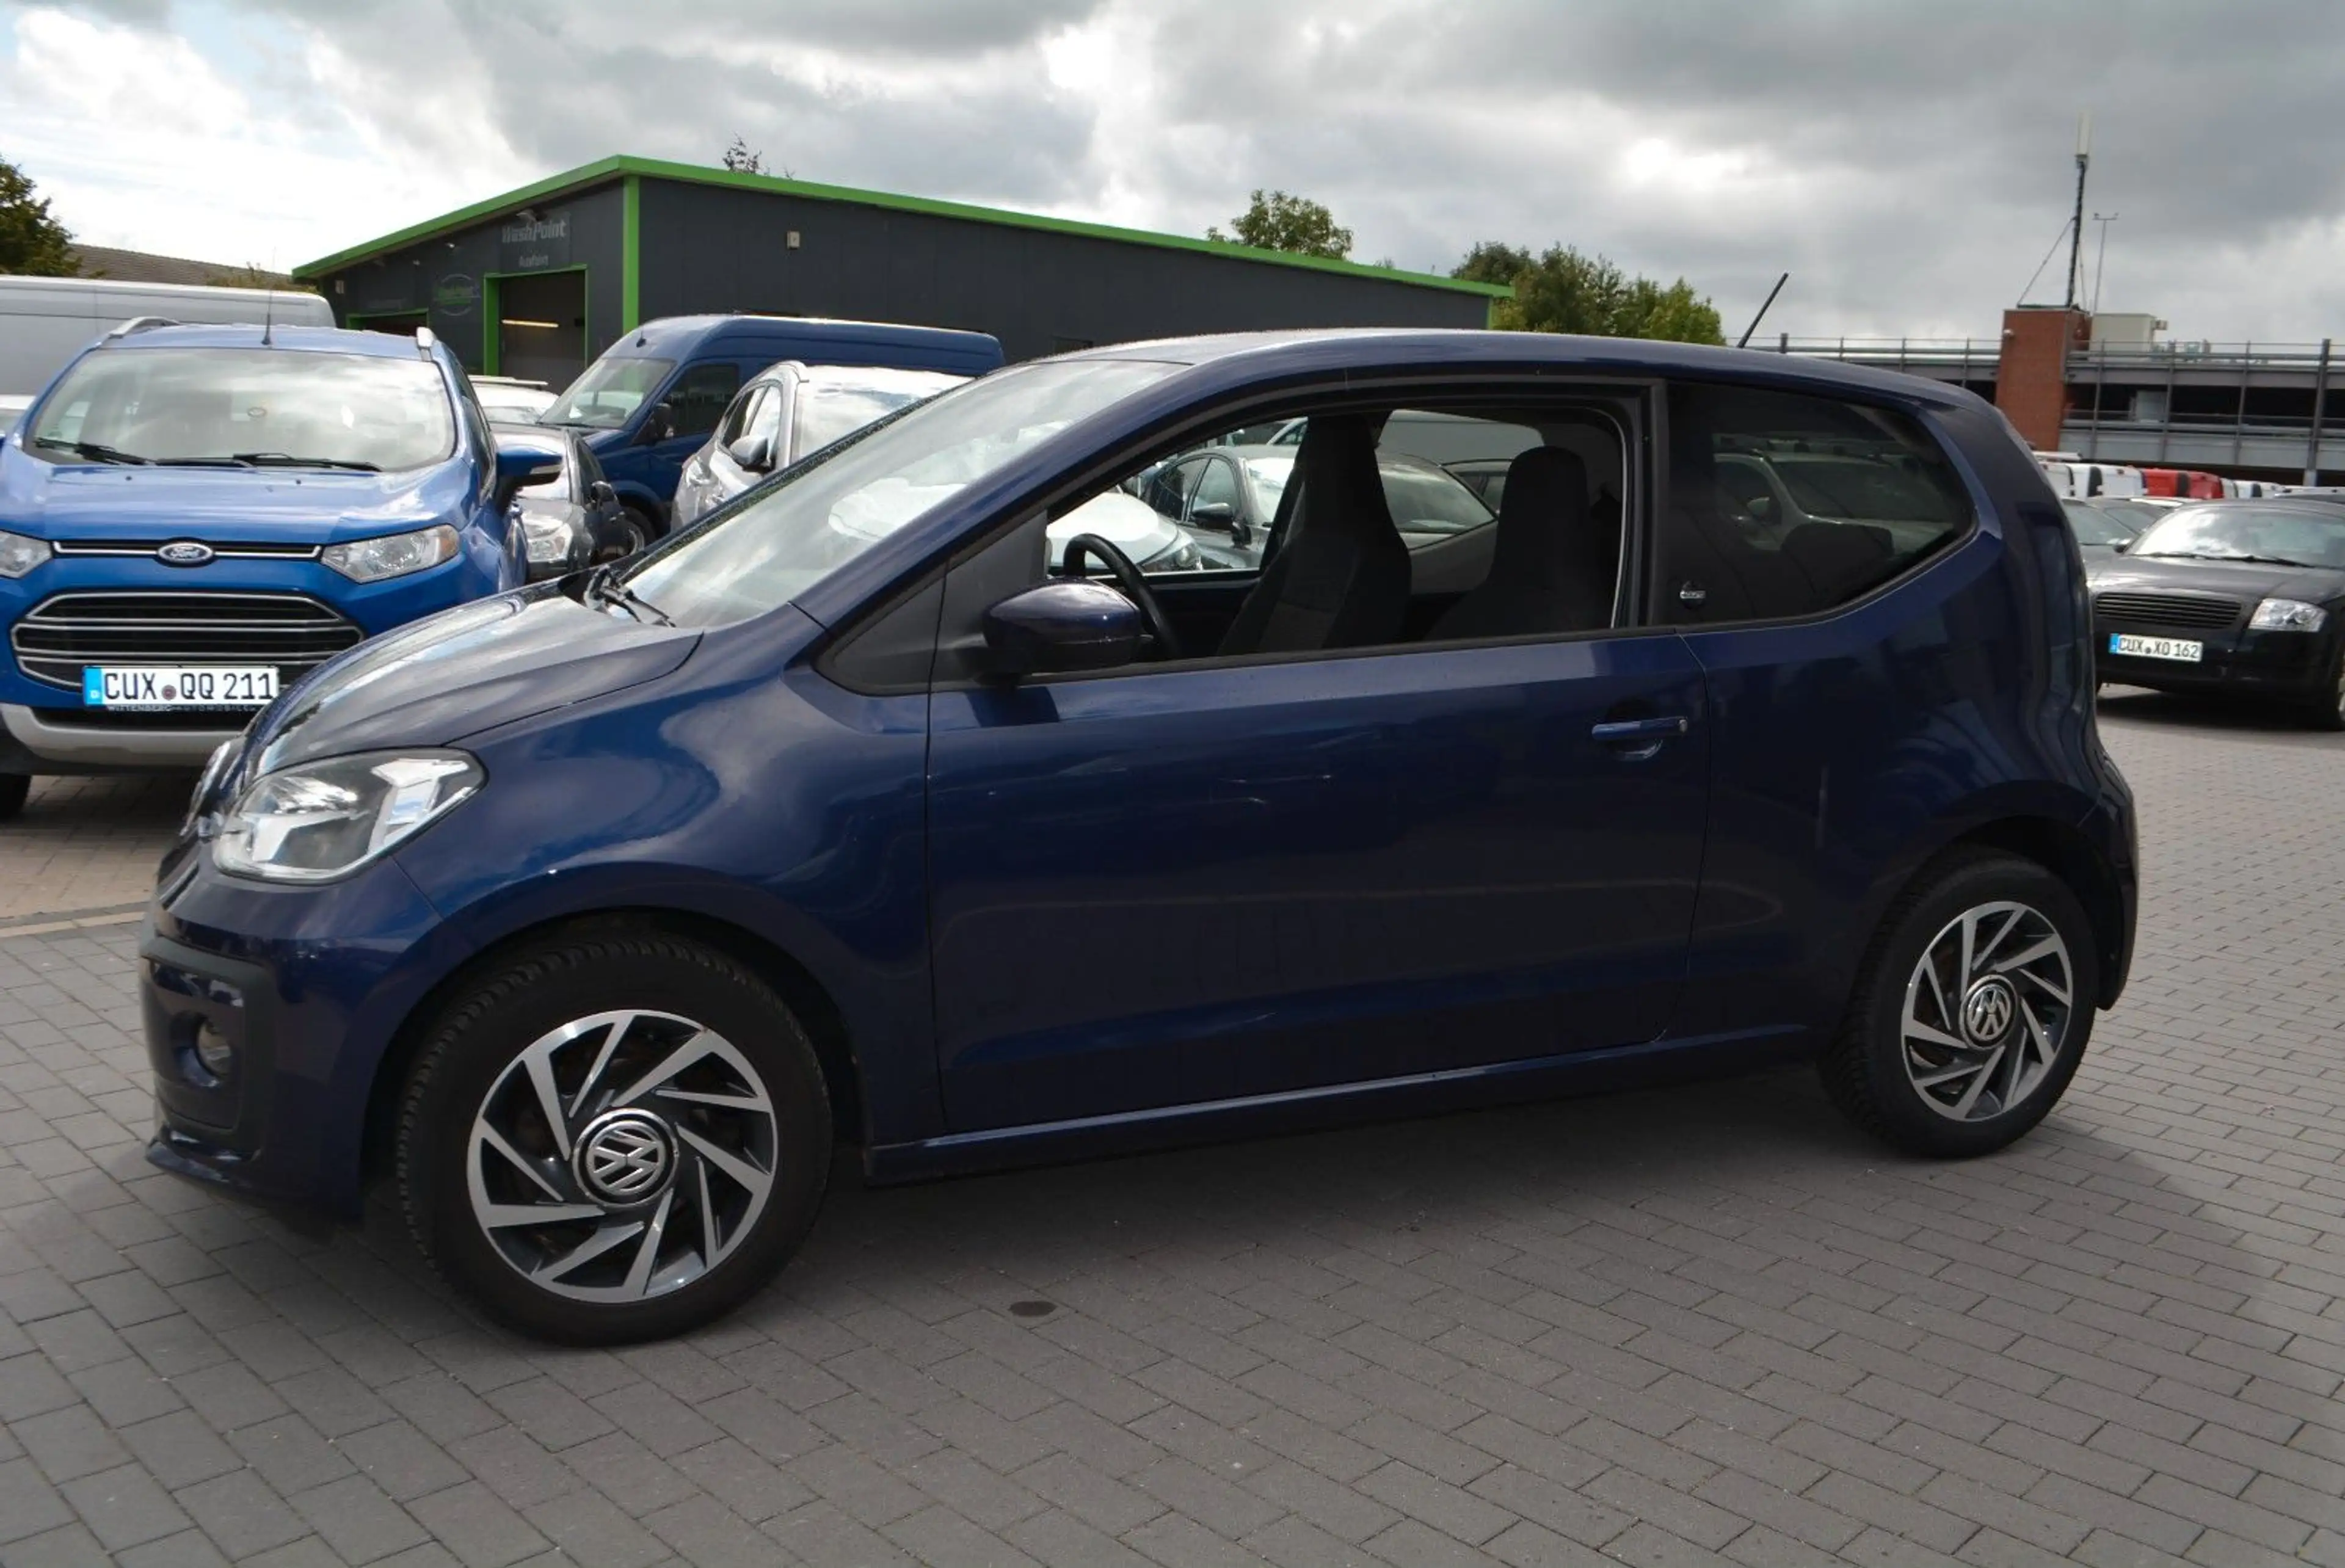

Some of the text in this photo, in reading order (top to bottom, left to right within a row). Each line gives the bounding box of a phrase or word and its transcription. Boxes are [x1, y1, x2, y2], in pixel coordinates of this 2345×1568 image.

[2118, 637, 2144, 653] CUX
[2174, 643, 2199, 658] 162
[104, 672, 157, 700] CUX
[180, 672, 215, 700] QQ
[223, 672, 275, 700] 211
